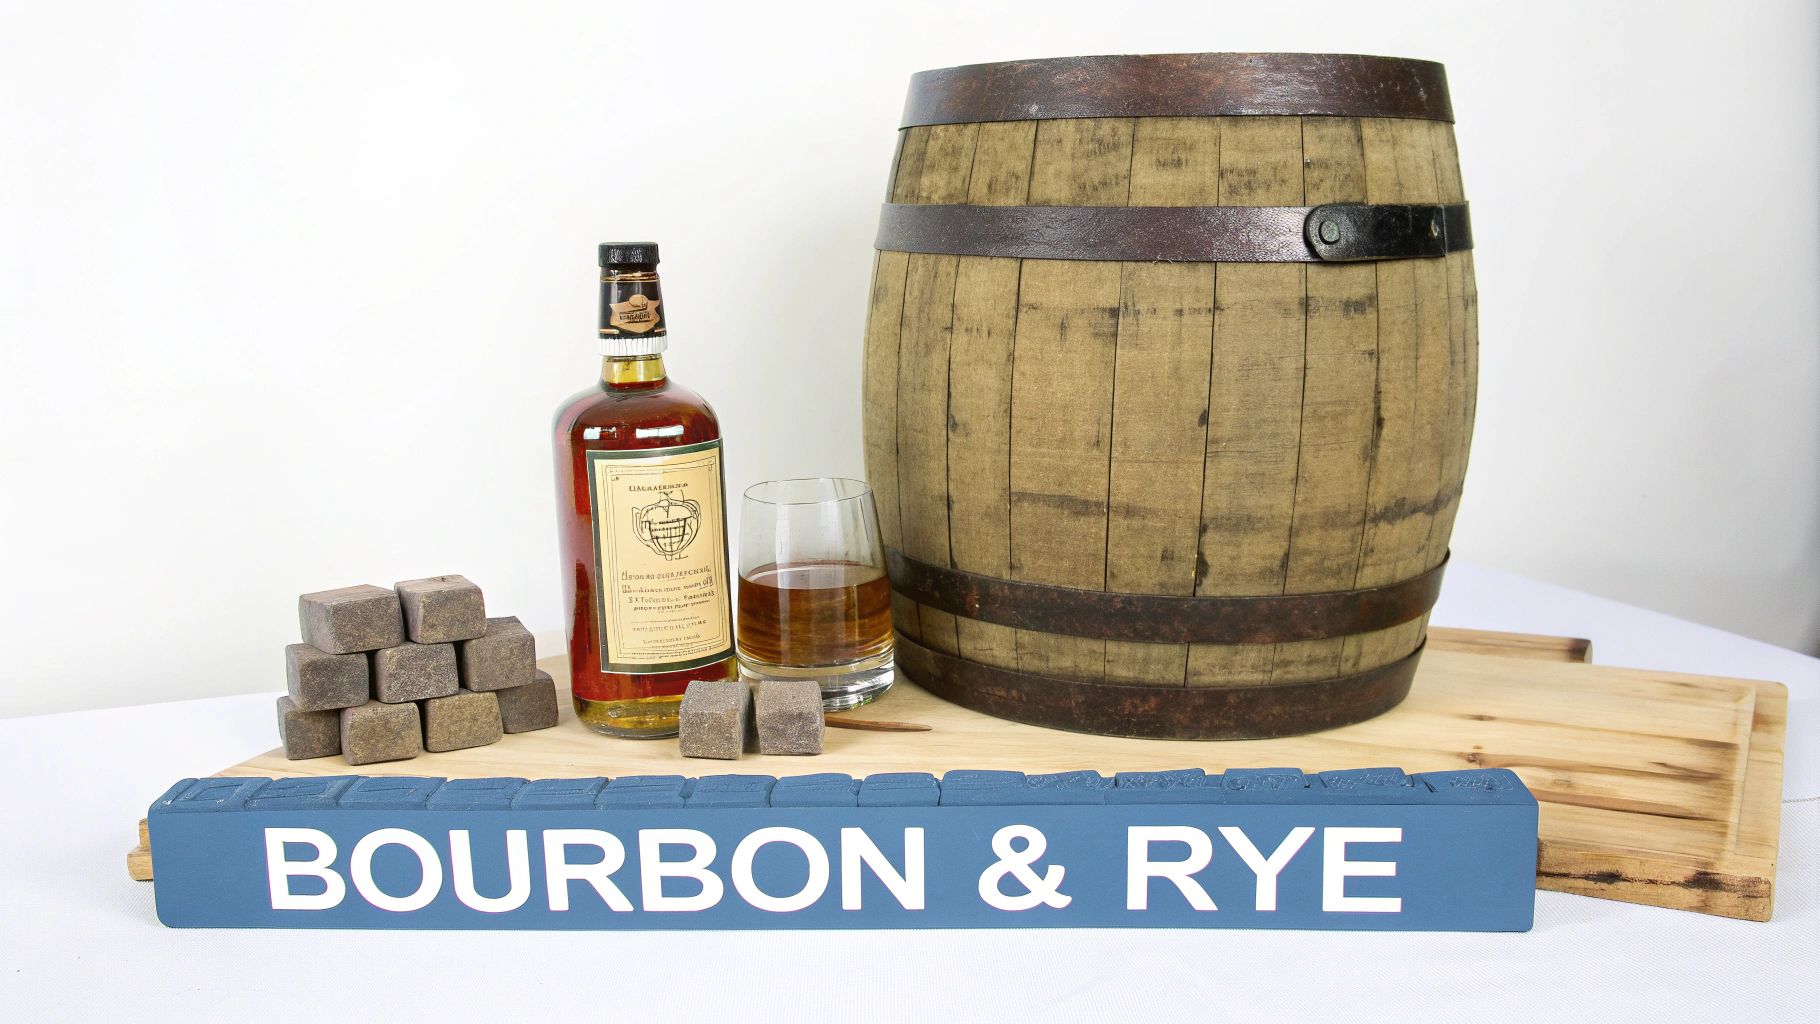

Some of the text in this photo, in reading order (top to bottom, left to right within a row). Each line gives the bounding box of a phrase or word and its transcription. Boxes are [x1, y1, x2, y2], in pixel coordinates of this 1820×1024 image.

[264, 825, 1404, 913] BOURBON & RYE
